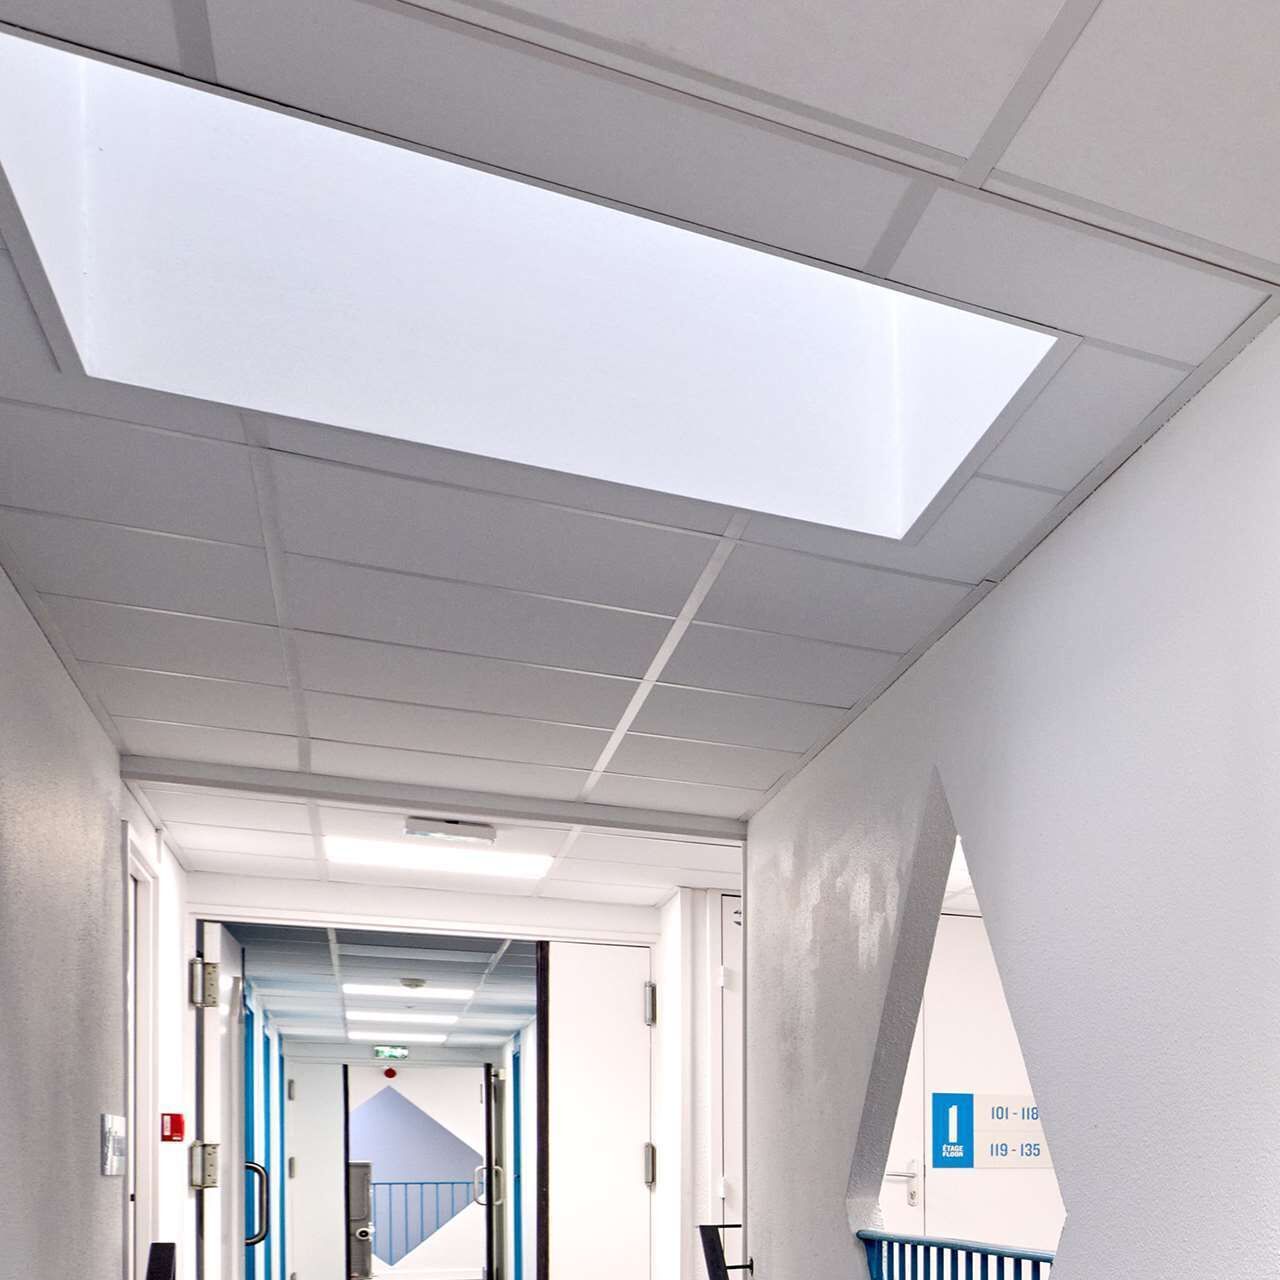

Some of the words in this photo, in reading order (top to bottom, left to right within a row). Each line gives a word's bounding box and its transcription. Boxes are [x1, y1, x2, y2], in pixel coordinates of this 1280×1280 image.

[991, 1106, 1009, 1120] 101
[1021, 1106, 1040, 1120] 118
[942, 1144, 964, 1152] ÉTAGE
[990, 1143, 1008, 1157] 119
[1020, 1143, 1040, 1157] 135
